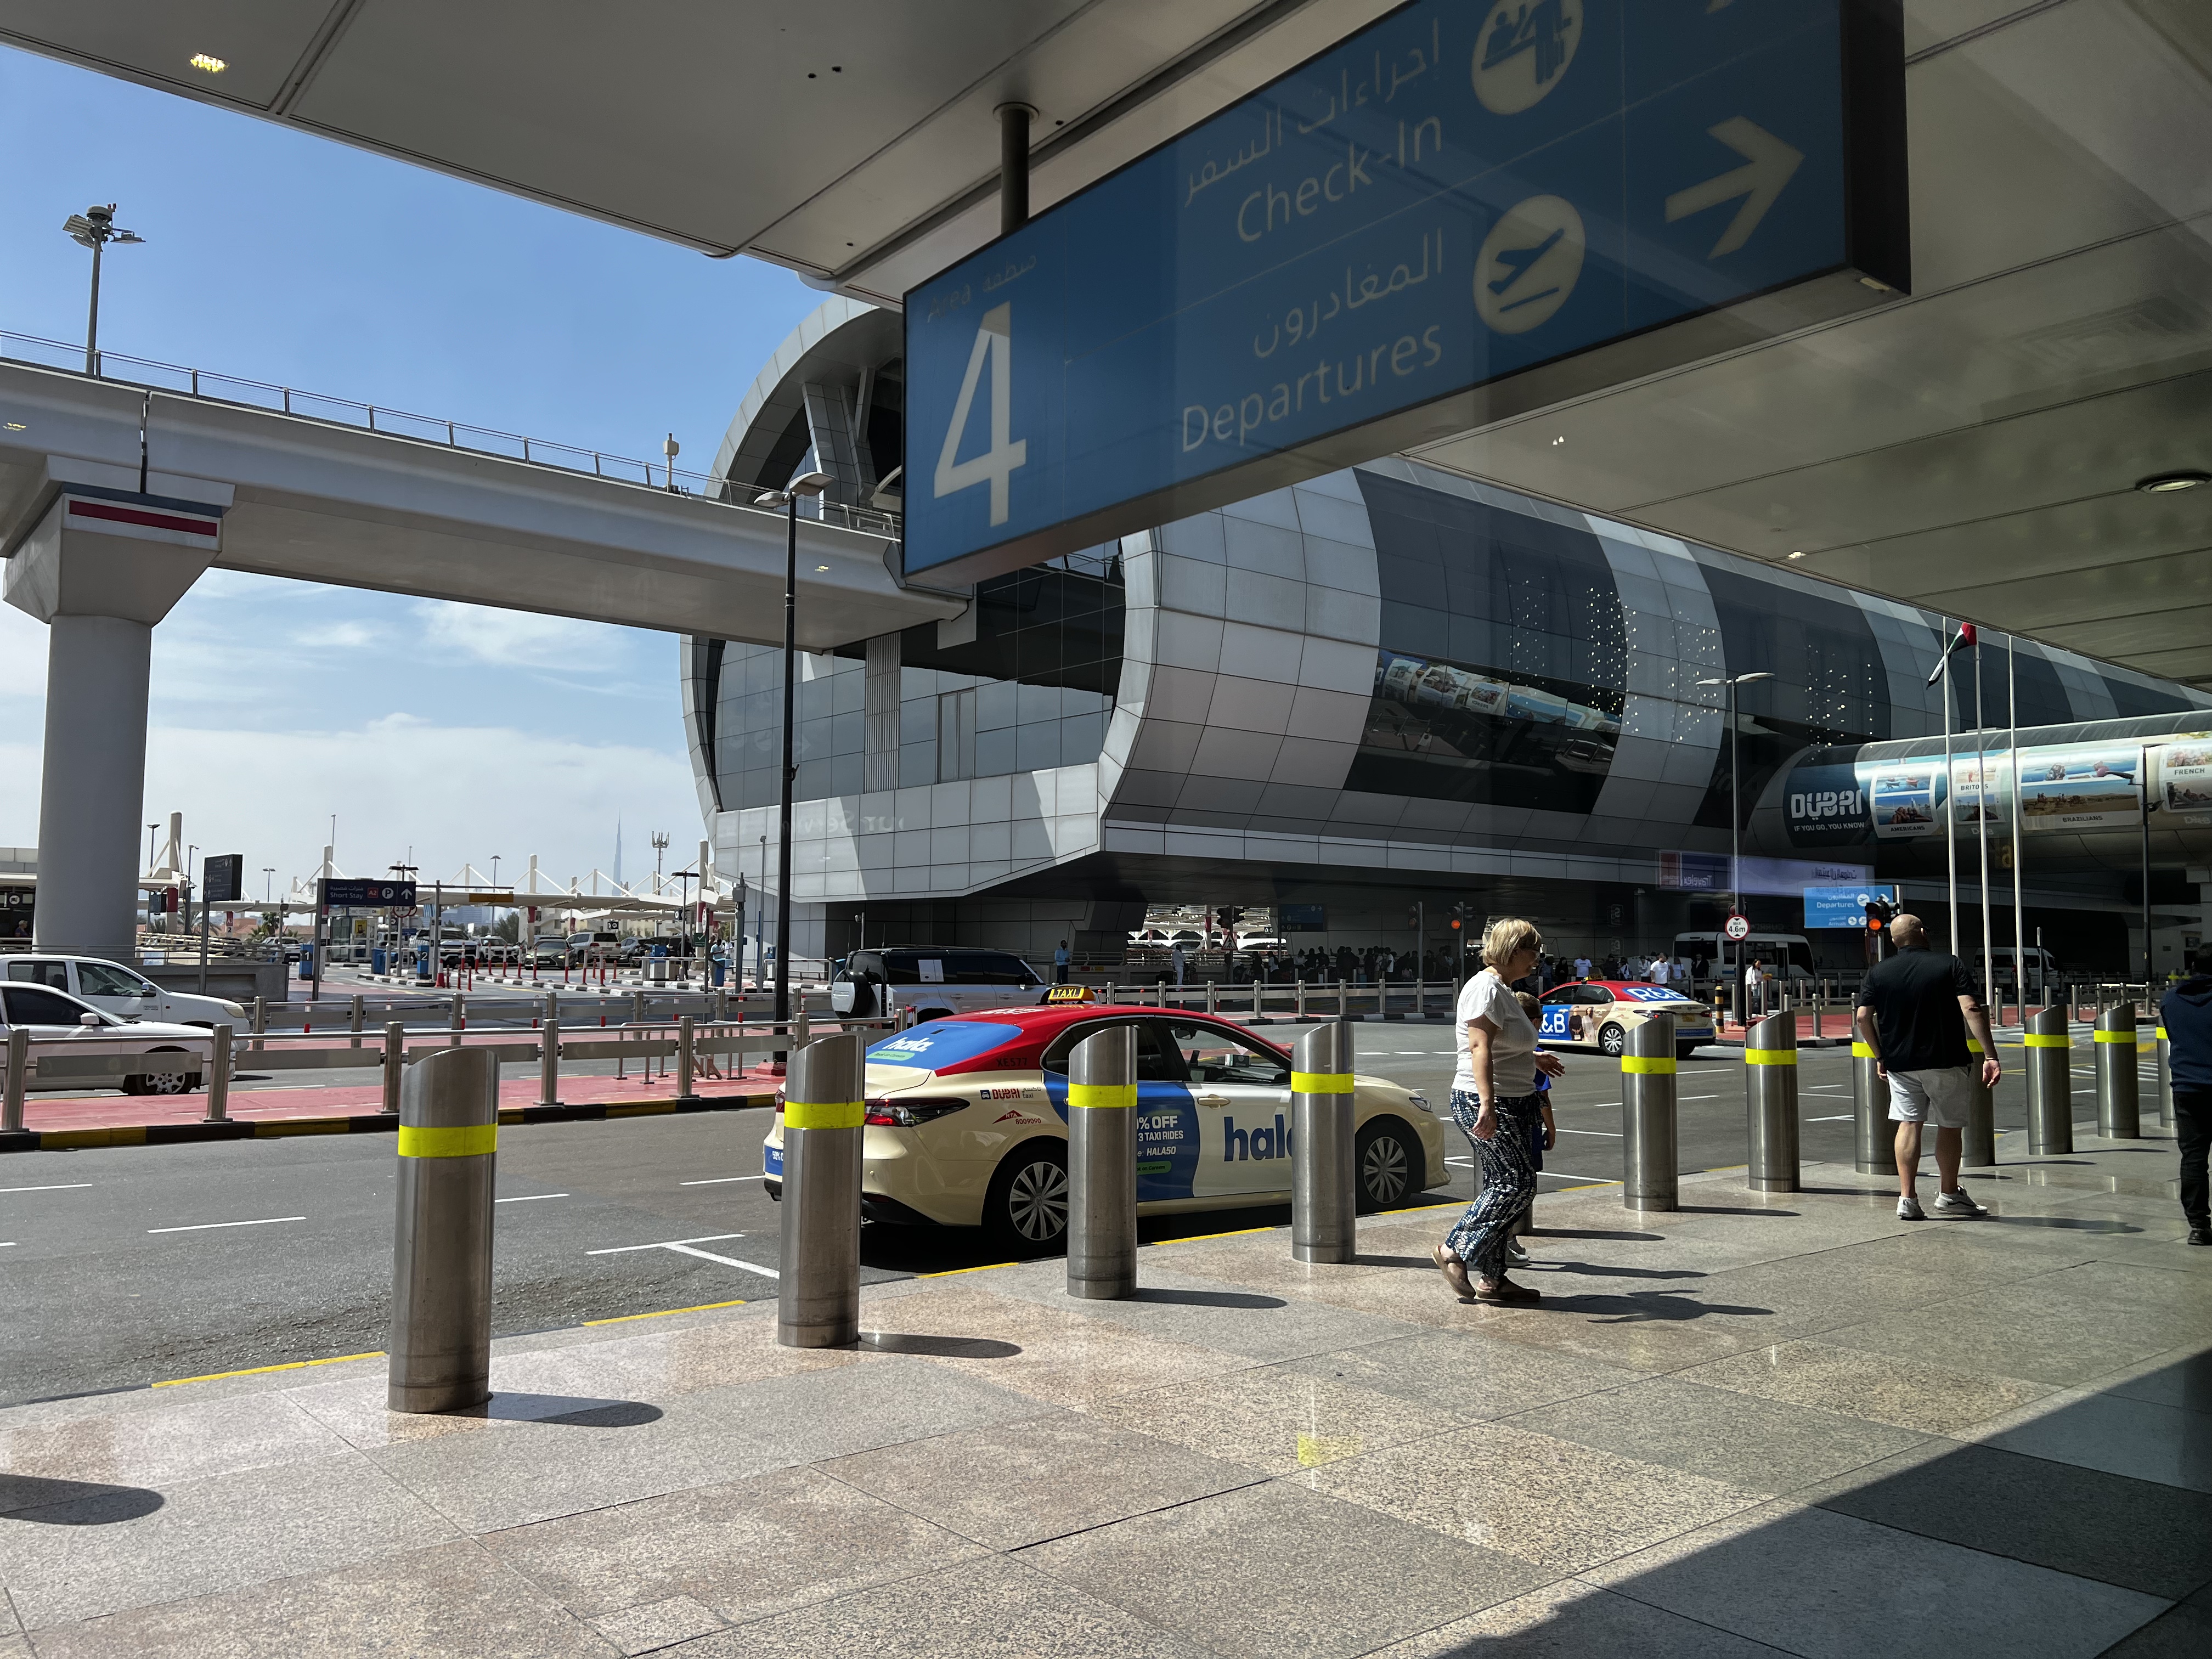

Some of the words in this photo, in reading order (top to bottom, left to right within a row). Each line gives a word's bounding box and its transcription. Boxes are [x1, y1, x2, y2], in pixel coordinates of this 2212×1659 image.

[1184, 103, 1282, 208] السفر
[1238, 115, 1442, 242] Check-In
[927, 283, 971, 323] Area
[1254, 227, 1443, 359] المغادرون
[1182, 324, 1442, 454] Departures
[934, 300, 1026, 527] 4
[1791, 789, 1863, 820] DUBAI
[304, 952, 309, 961] 1
[421, 952, 427, 961] 2
[1056, 989, 1077, 998] TAXI
[1627, 988, 1689, 1001] R&B
[1538, 1013, 1566, 1033] &B
[992, 1088, 1020, 1101] DUBAI
[1152, 1115, 1178, 1129] OFF
[1138, 1132, 1144, 1142] 3
[1144, 1131, 1161, 1141] TAXI
[1163, 1130, 1184, 1140] RIDES
[1223, 1114, 1292, 1162] hal
[1146, 1146, 1177, 1156] HALA50
